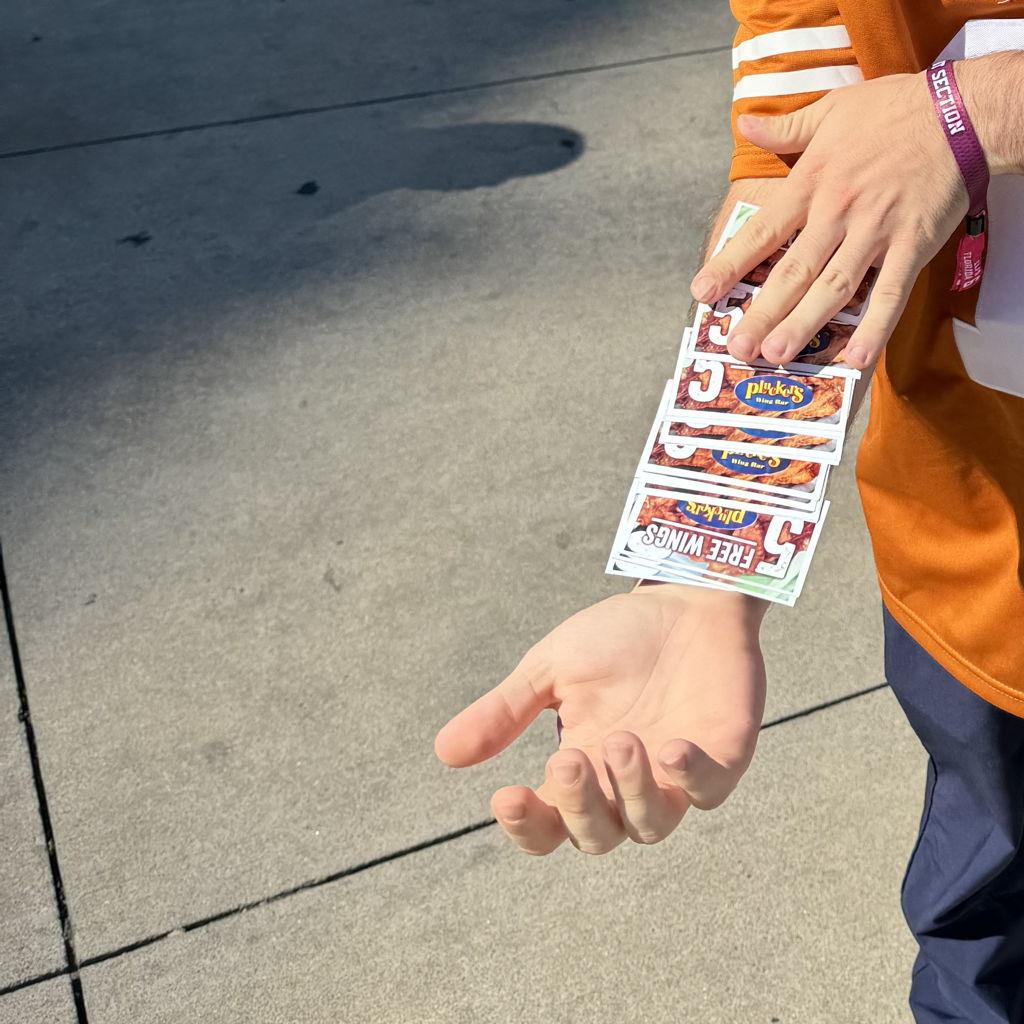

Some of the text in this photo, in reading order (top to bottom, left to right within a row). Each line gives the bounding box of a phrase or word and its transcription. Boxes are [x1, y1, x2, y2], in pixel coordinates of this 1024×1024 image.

[931, 71, 966, 136] SECTION
[641, 523, 756, 569] FREE WINGS
[755, 515, 802, 579] 5
